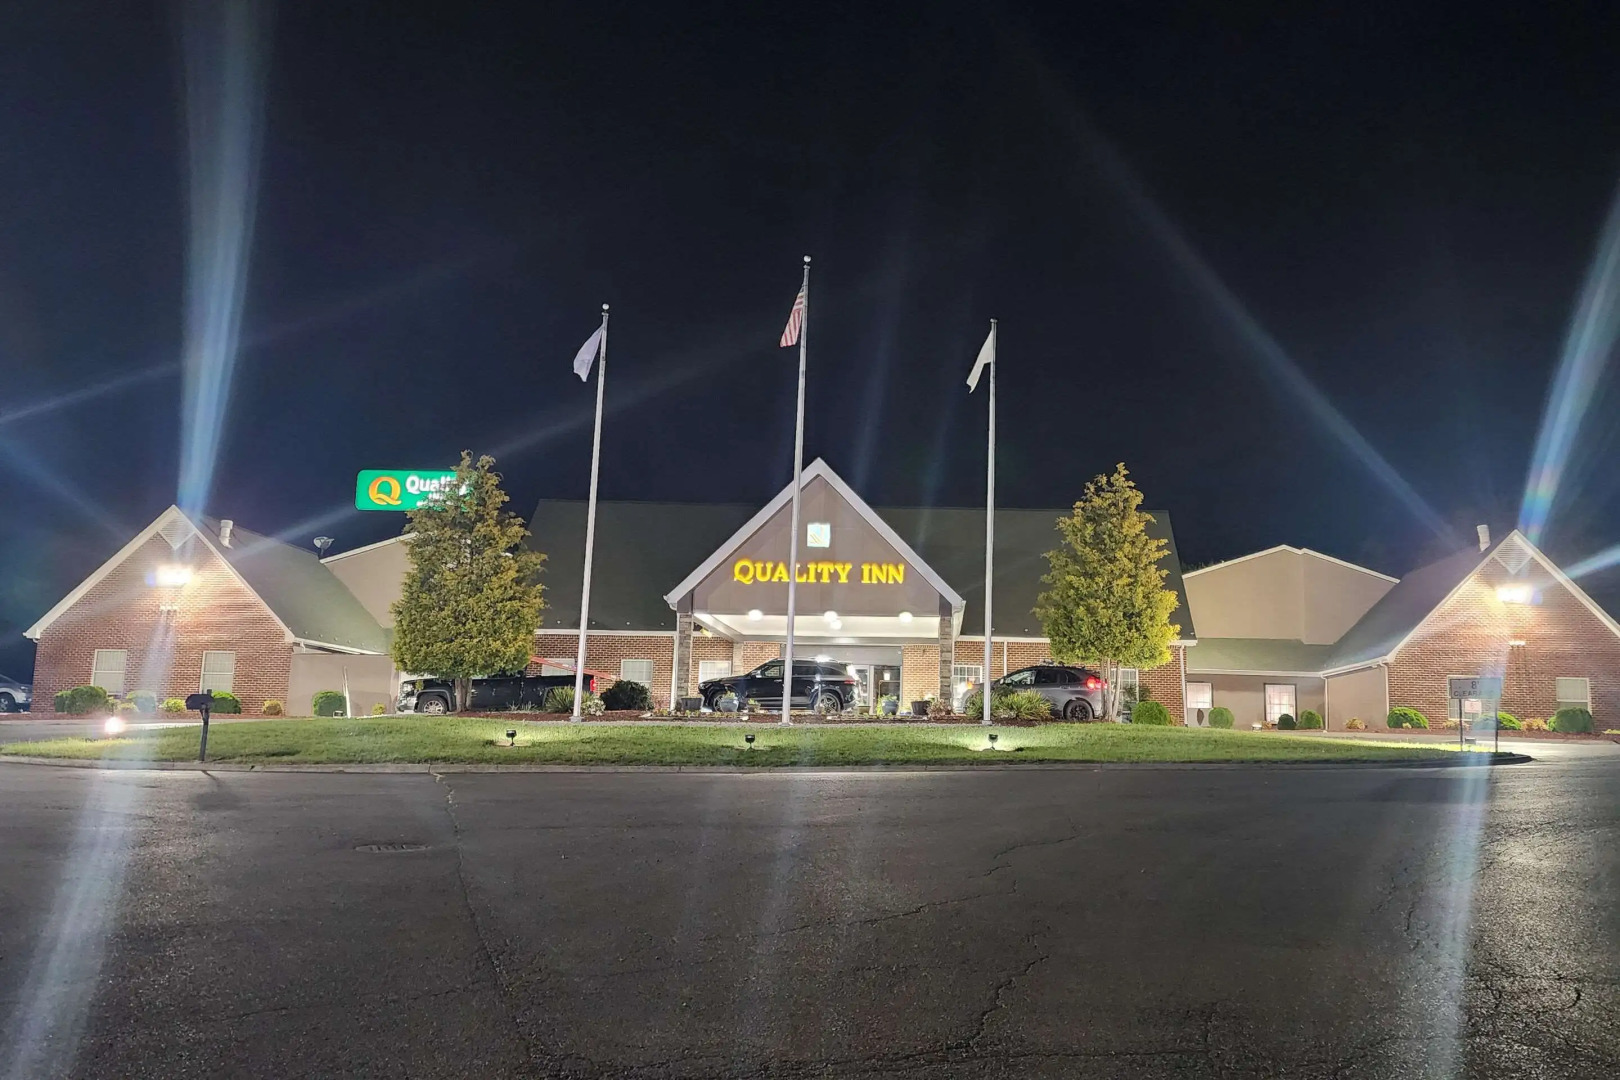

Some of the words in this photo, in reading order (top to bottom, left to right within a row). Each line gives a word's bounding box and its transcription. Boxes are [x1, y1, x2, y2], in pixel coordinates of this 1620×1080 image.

[368, 476, 402, 505] Q
[405, 475, 469, 496] Qualiy
[733, 558, 852, 585] QUALITY
[861, 563, 905, 584] INN
